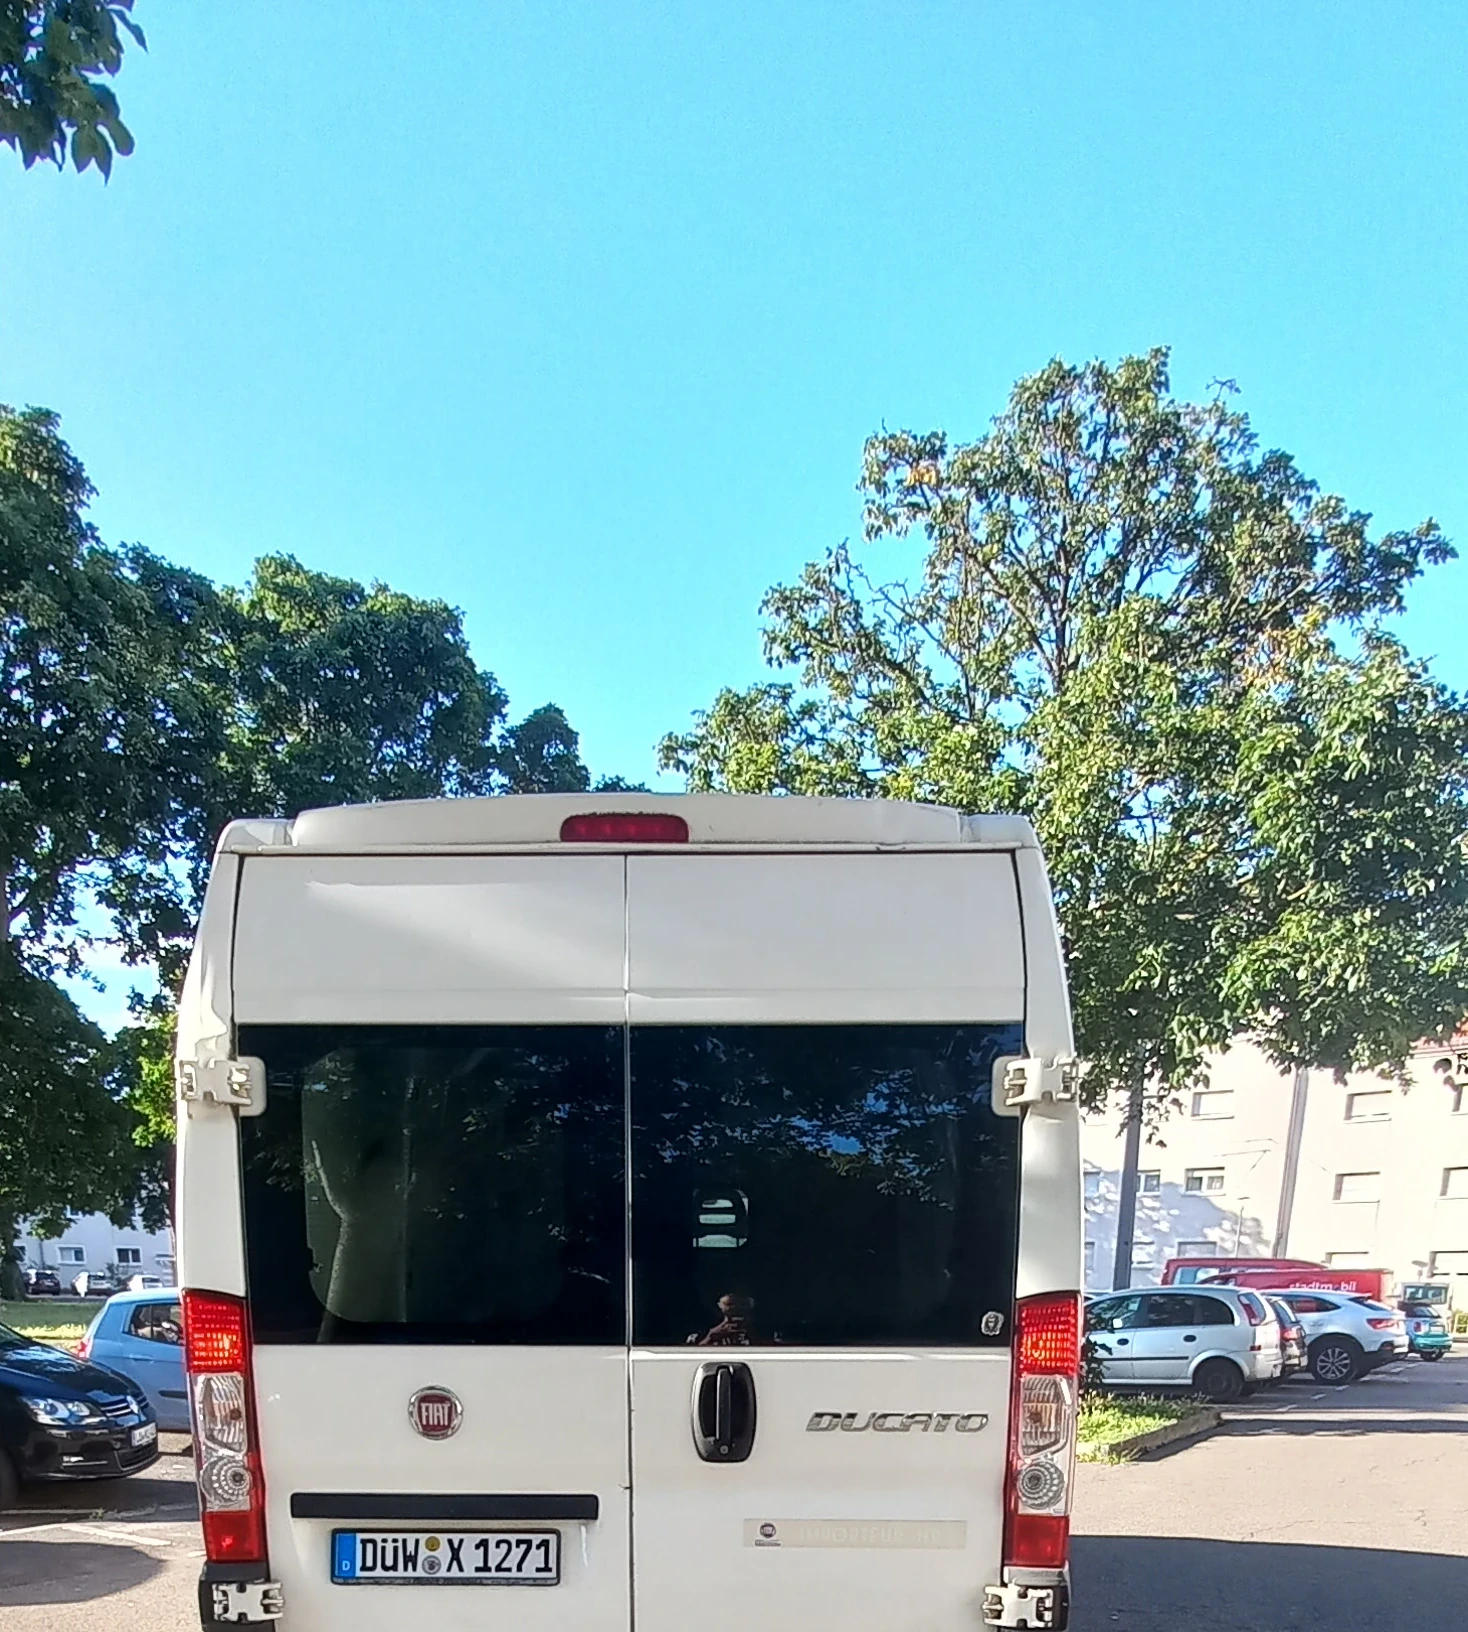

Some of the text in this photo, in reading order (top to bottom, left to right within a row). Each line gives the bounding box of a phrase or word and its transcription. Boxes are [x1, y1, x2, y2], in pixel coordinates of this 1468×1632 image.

[420, 1402, 450, 1426] FIAT
[805, 1412, 988, 1433] DUCATO
[342, 1560, 351, 1571] D
[359, 1538, 553, 1573] DÜW X 1271
